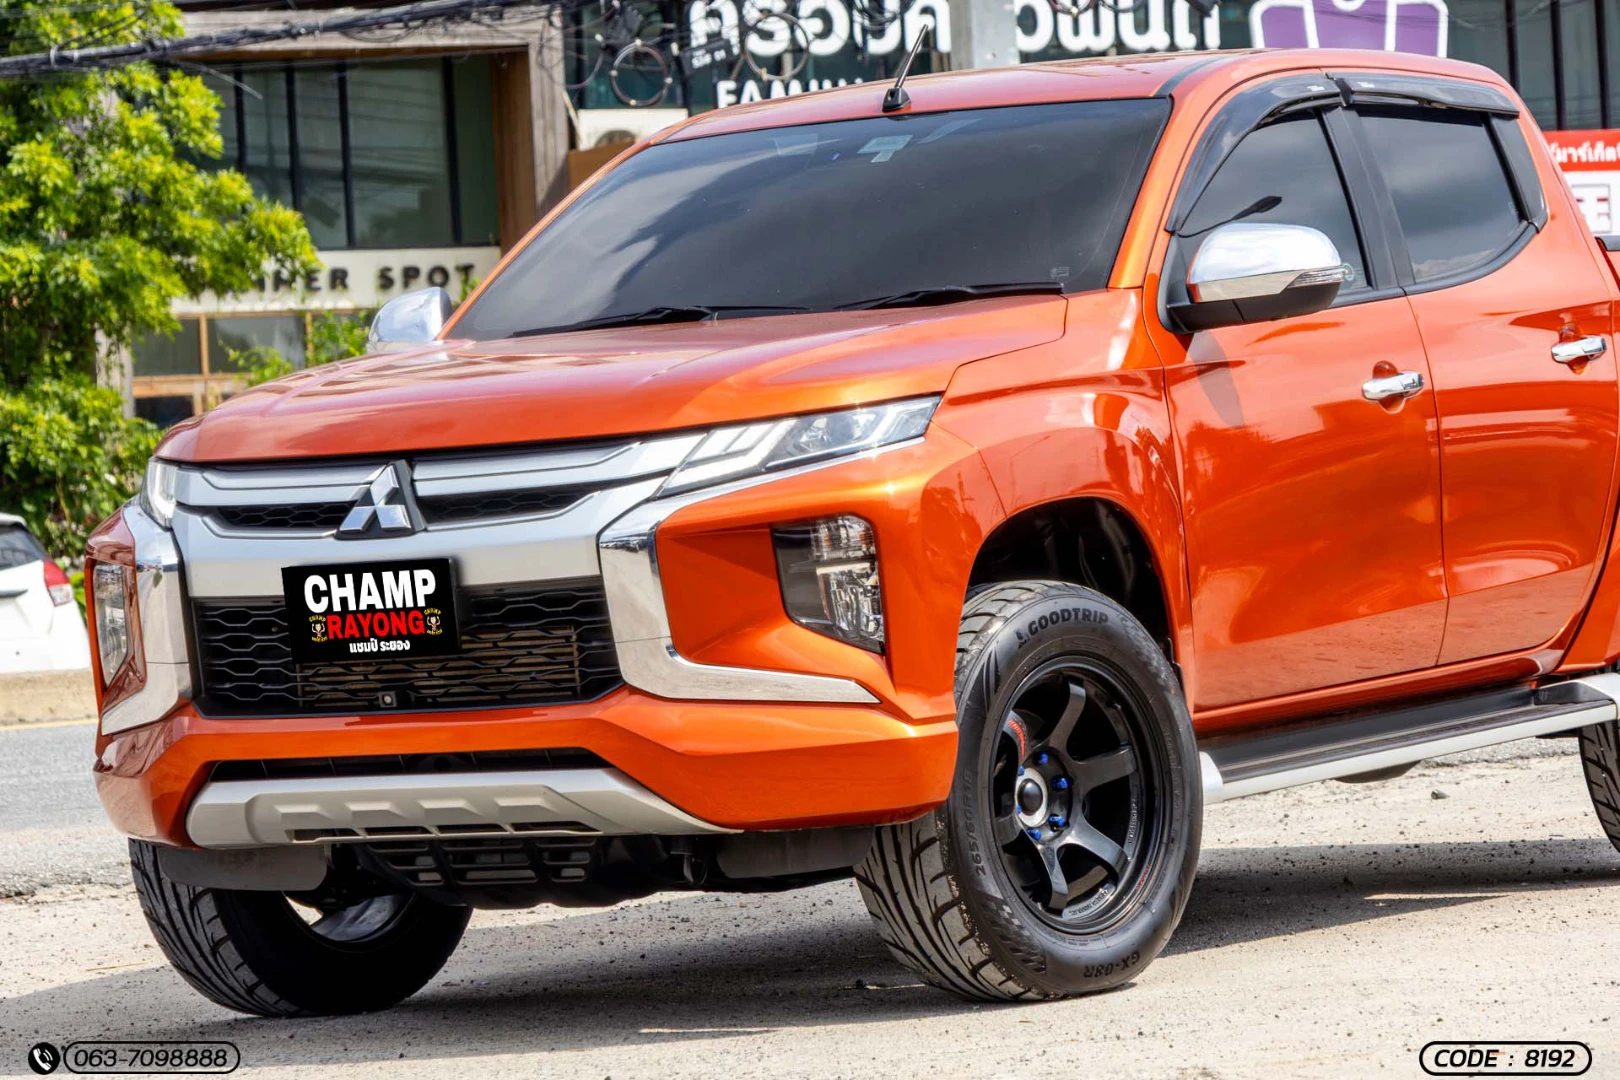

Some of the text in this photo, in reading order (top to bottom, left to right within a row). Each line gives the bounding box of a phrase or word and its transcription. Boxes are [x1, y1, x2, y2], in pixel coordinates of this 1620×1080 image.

[376, 263, 475, 292] SPOT
[1027, 607, 1110, 636] GOODTRIP
[963, 768, 987, 877] 265/60R18
